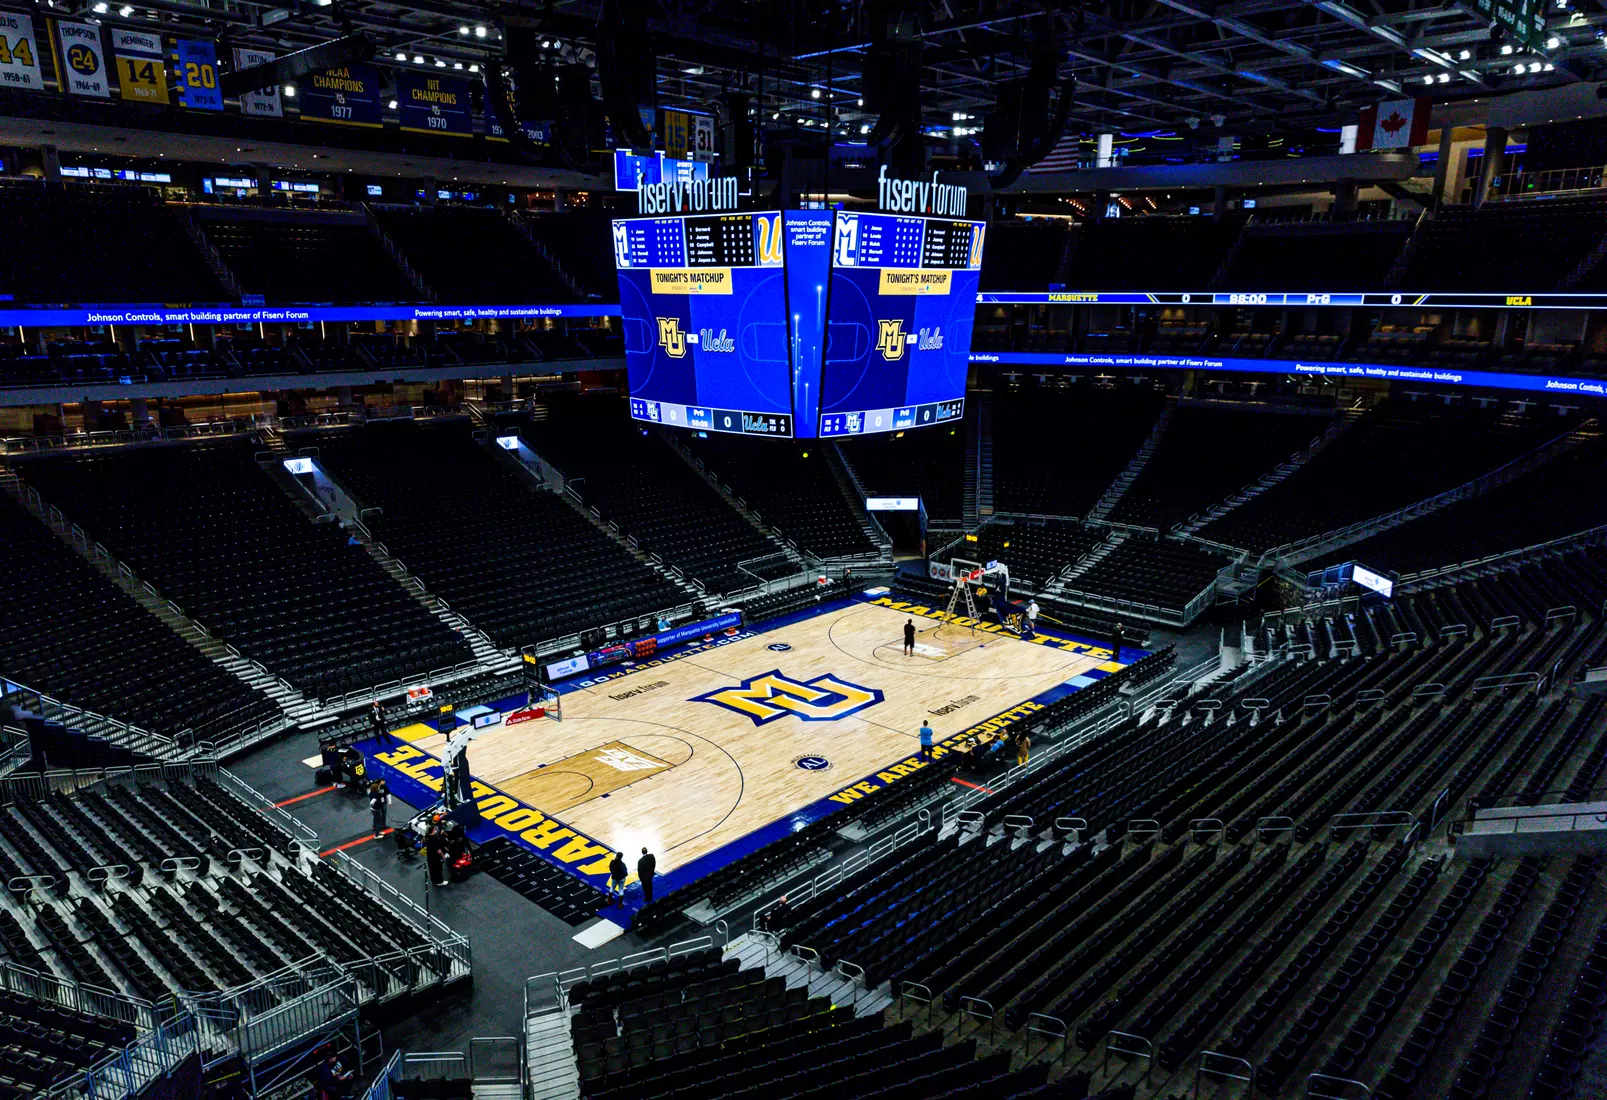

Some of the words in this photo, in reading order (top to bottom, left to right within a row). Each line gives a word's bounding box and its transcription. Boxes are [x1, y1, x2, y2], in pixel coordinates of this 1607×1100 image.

[0, 16, 19, 29] OJIS
[61, 27, 97, 41] THOMPSON
[120, 35, 155, 50] MEMINGER
[71, 47, 96, 71] 24
[3, 71, 31, 84] 1958-61
[126, 59, 158, 85] 14
[185, 62, 216, 89] 20
[313, 76, 364, 93] CHAMPIONS
[427, 79, 440, 90] NIT
[412, 89, 457, 105] CHAMPIONS
[331, 105, 352, 119] 1977
[427, 116, 447, 129] 1970
[667, 124, 686, 152] 15
[697, 129, 712, 152] 31
[656, 272, 688, 283] TONIGHT'S
[690, 272, 724, 283] MATCHUP
[886, 273, 919, 284] TONIGHT'S
[920, 274, 947, 284] MATCHUP
[1182, 294, 1190, 303] 0
[1391, 294, 1402, 304] 0
[1506, 296, 1532, 305] UCLA
[87, 314, 123, 325] Johnson
[126, 313, 163, 321] Controls,
[190, 312, 221, 324] building
[224, 313, 251, 321] partner
[263, 311, 284, 319] Fiserv
[540, 308, 562, 316] buildings
[656, 317, 687, 358] MU
[875, 320, 907, 361] MU
[1296, 364, 1325, 373] Powering
[1366, 368, 1387, 376] healthy
[1434, 373, 1461, 382] buildings
[1546, 381, 1577, 389] Johnson
[1579, 383, 1604, 393] Controls,
[670, 410, 676, 420] 0
[724, 416, 732, 428] 0
[875, 416, 882, 426] 0
[924, 410, 930, 421] 0
[681, 628, 700, 638] Marquette
[701, 623, 719, 632] University
[686, 668, 885, 727] MU
[828, 781, 880, 805] WE
[876, 756, 929, 784] ARE
